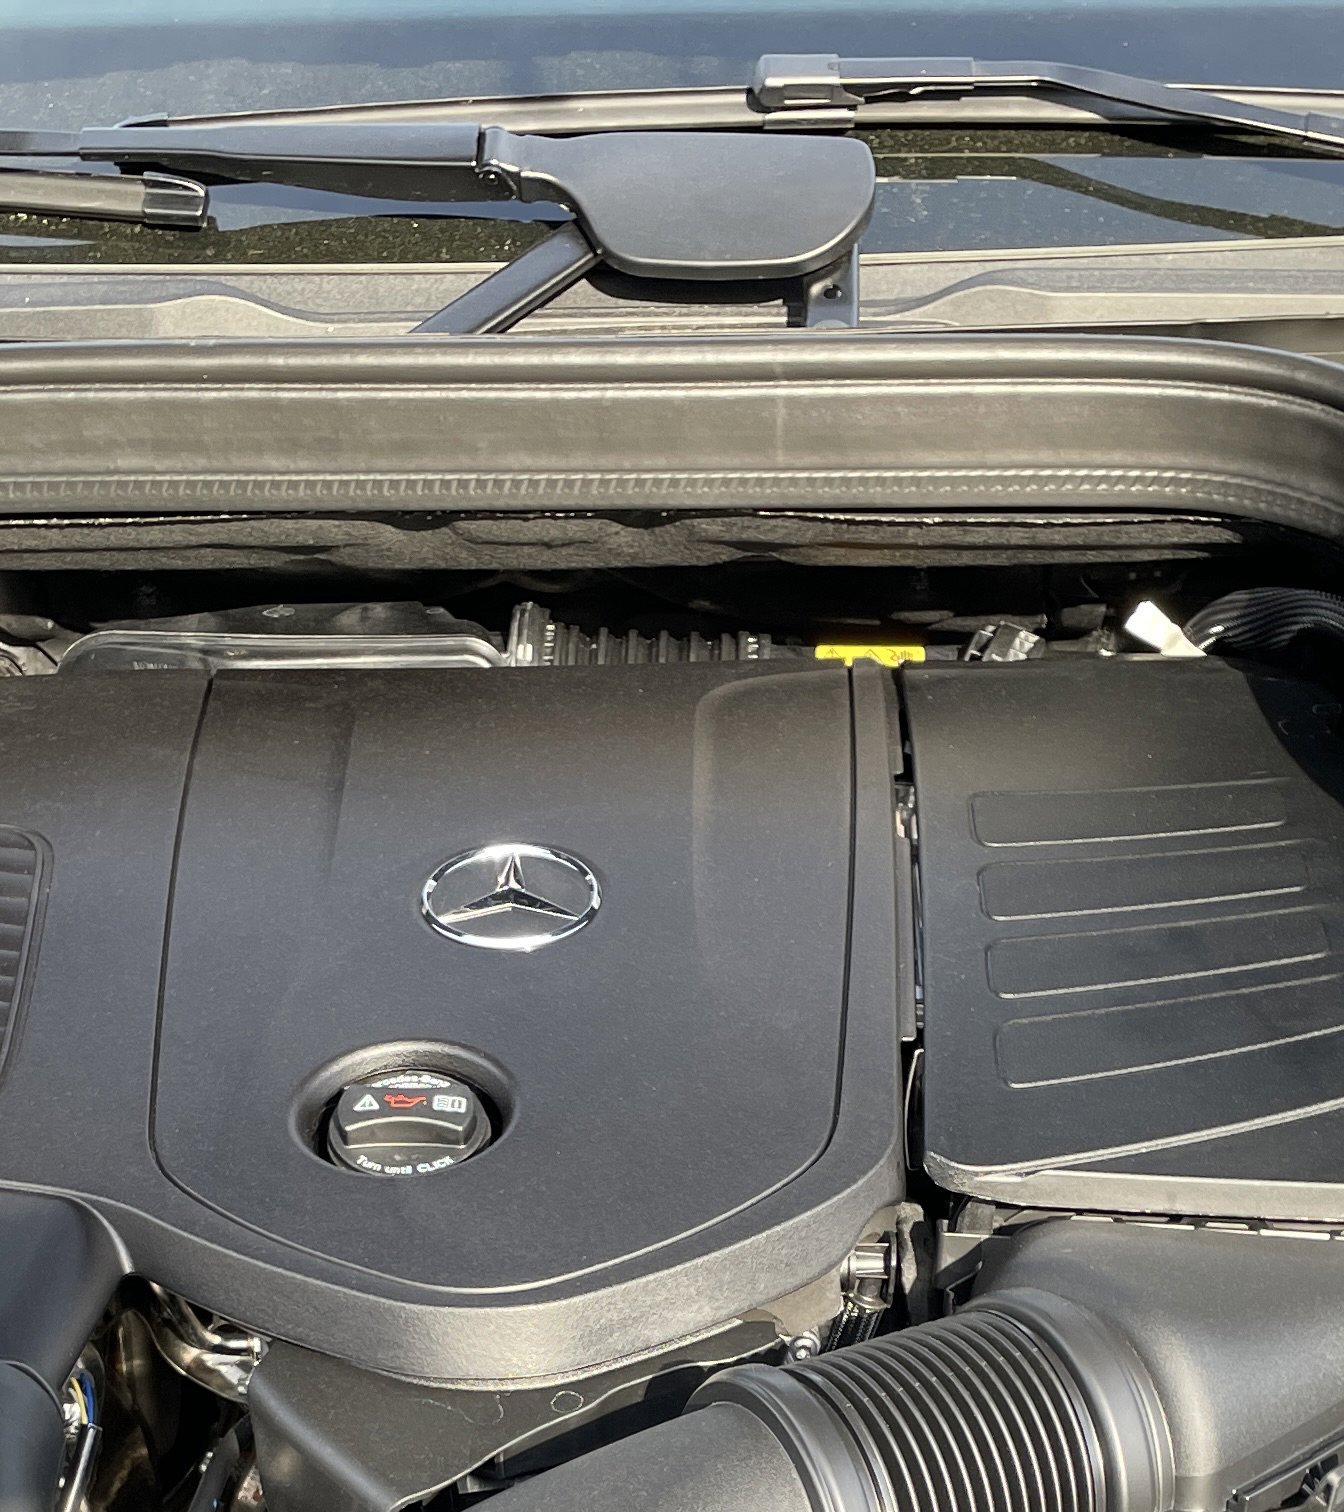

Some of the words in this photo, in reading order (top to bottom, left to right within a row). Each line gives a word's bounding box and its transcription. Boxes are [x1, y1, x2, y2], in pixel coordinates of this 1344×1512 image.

[356, 1154, 382, 1171] Turn
[384, 1165, 413, 1175] until
[416, 1155, 455, 1173] CLICK
